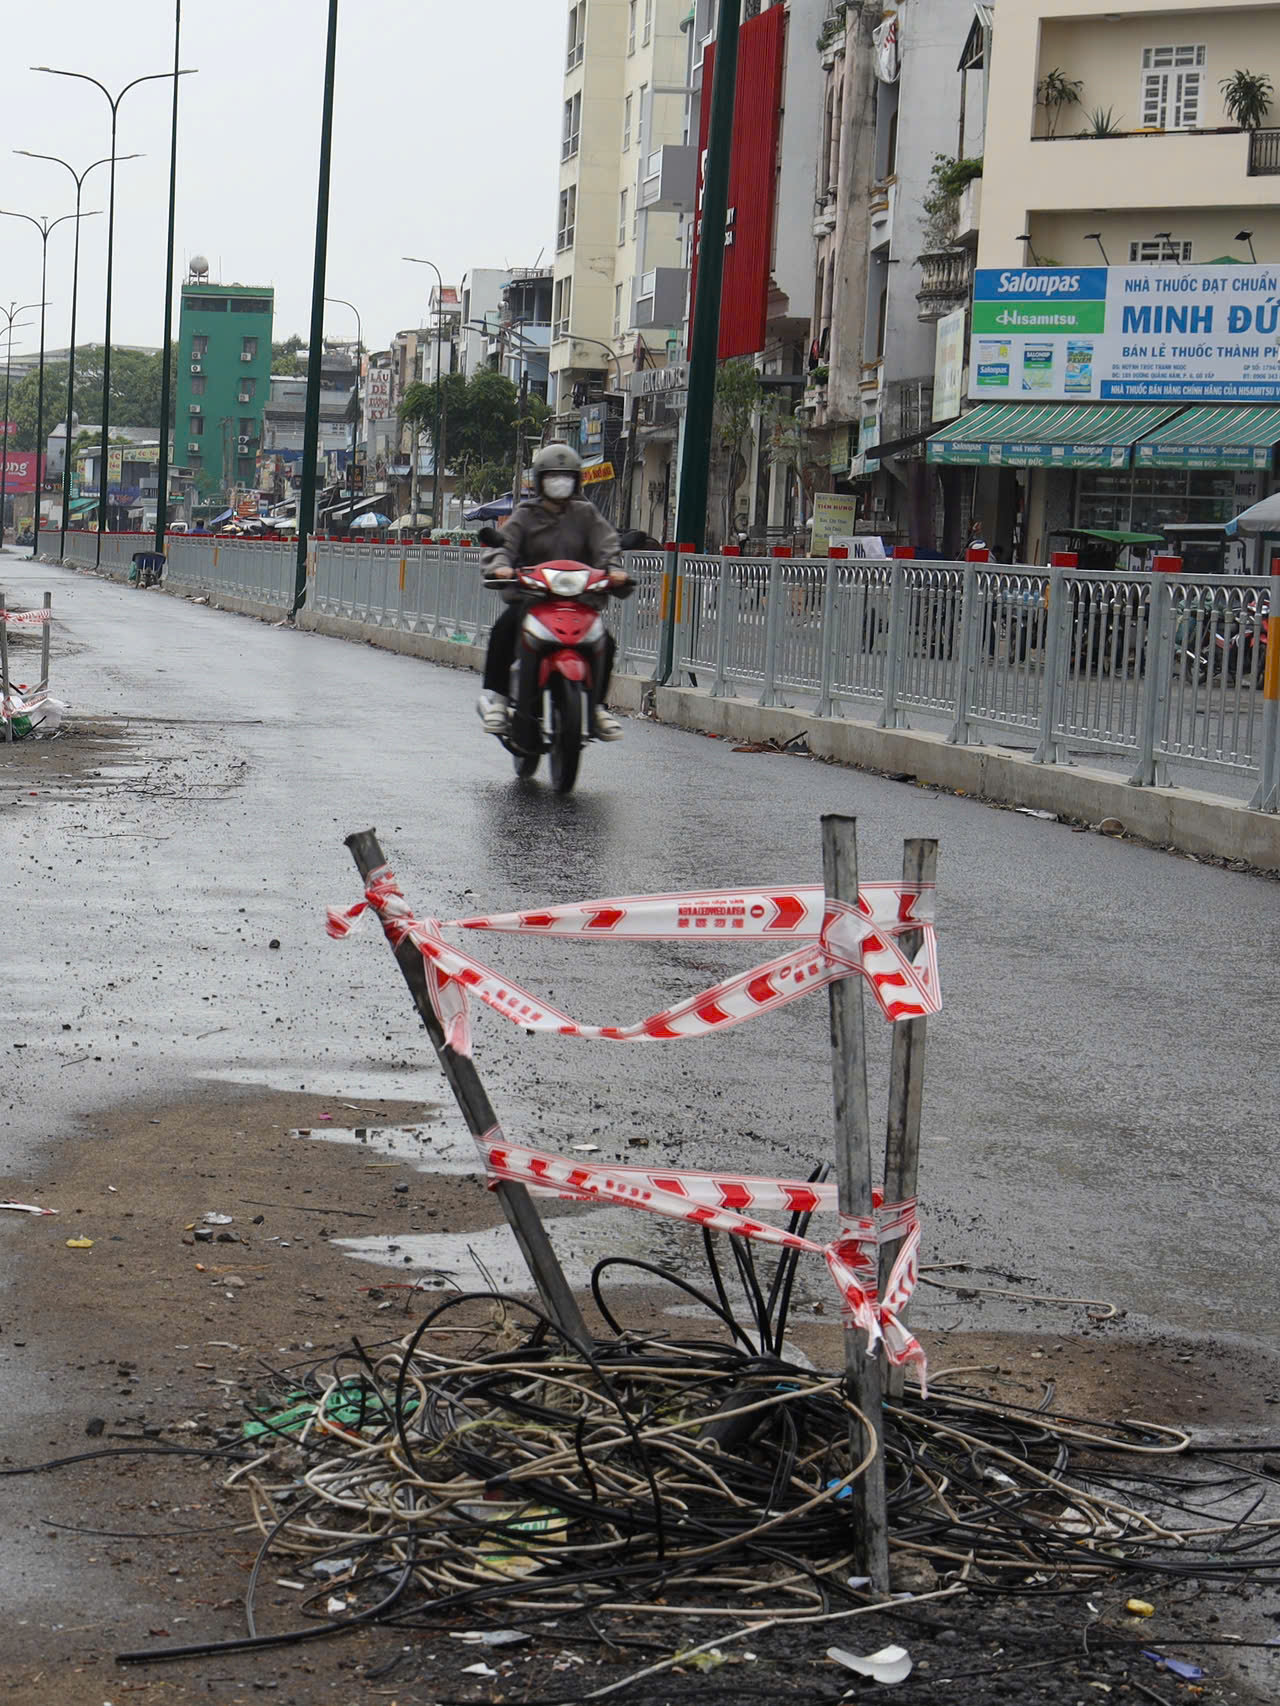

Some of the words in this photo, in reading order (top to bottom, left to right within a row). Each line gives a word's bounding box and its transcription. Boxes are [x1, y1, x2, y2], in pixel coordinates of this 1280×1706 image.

[998, 272, 1080, 296] Salonpas
[1125, 276, 1150, 292] NHÀ
[1155, 274, 1198, 292] THUỐC
[1202, 278, 1228, 294] ĐẠT
[1232, 271, 1277, 291] CHUẨN
[995, 310, 1077, 325] Hisamitsu
[1122, 305, 1213, 334] MINH
[1123, 344, 1147, 357] BÁN
[1152, 342, 1166, 357] LẺ
[1171, 343, 1213, 357] THUỐC
[1217, 344, 1259, 357] THÀNH
[1111, 384, 1124, 395] NHÀ
[1126, 382, 1147, 395] THUỐC
[1223, 383, 1238, 395] CỦA
[1239, 386, 1274, 396] HISAMITSU
